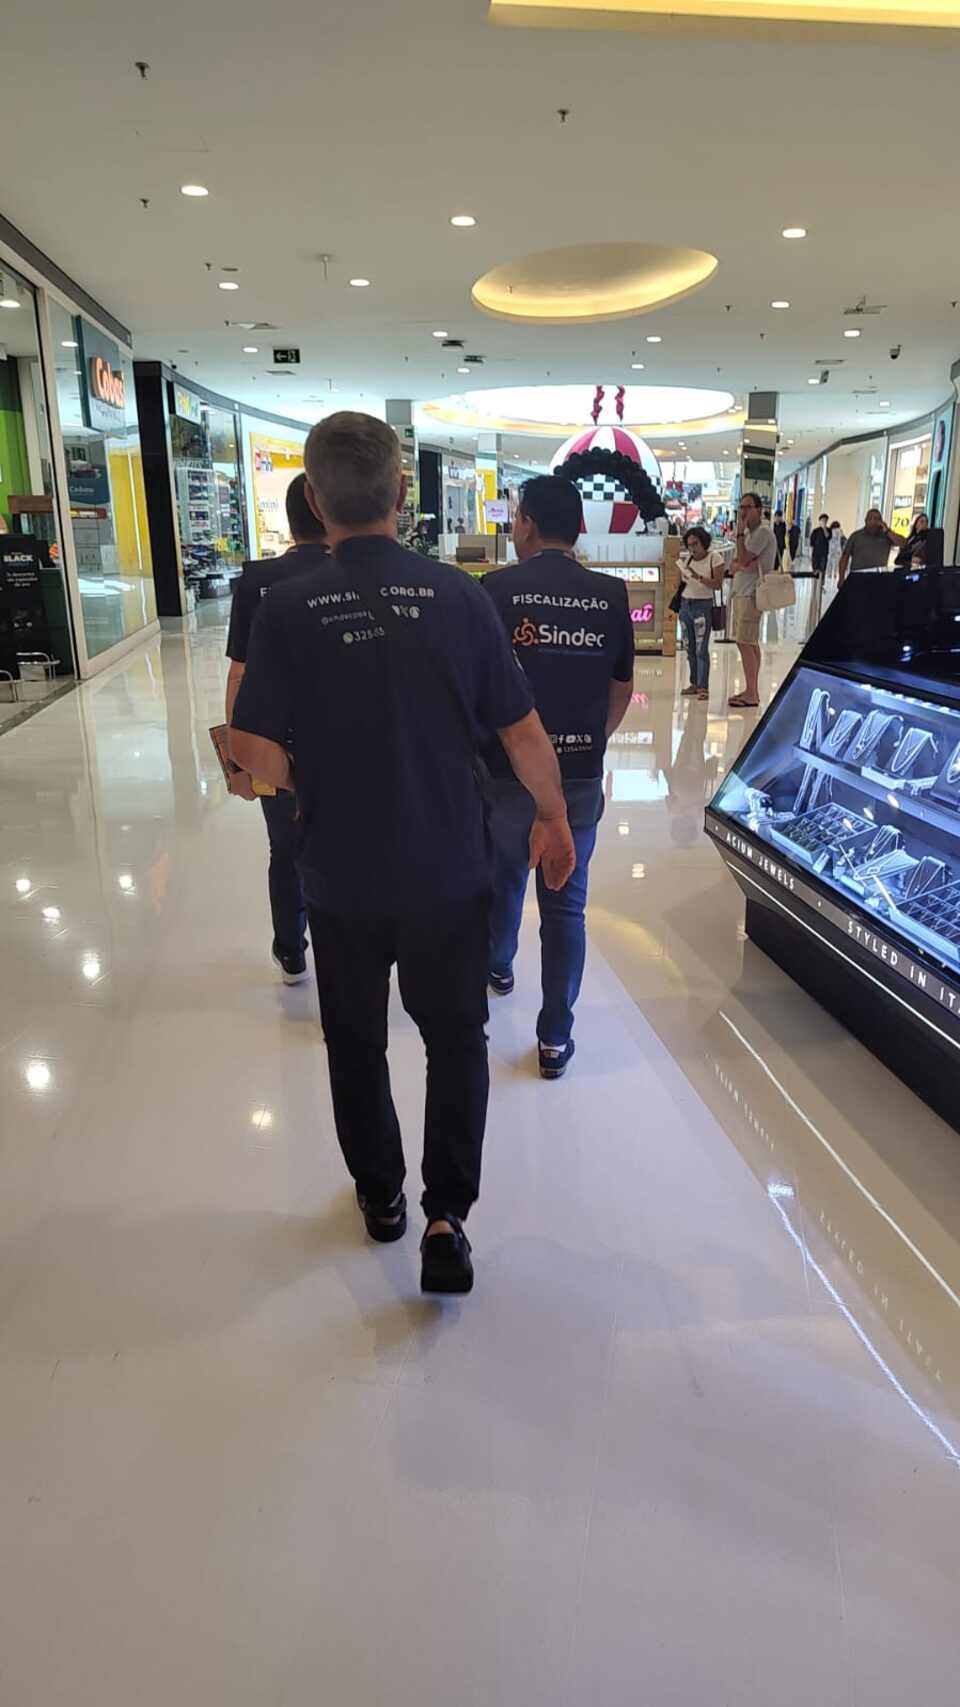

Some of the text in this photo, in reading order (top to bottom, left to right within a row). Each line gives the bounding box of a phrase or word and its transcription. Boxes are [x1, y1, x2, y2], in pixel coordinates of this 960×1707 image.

[512, 594, 608, 611] FISCALIZAÇÃO
[539, 624, 605, 647] Sindec
[726, 832, 794, 890] ACIUM JEWELS
[848, 921, 960, 1014] STYLED IN IT
